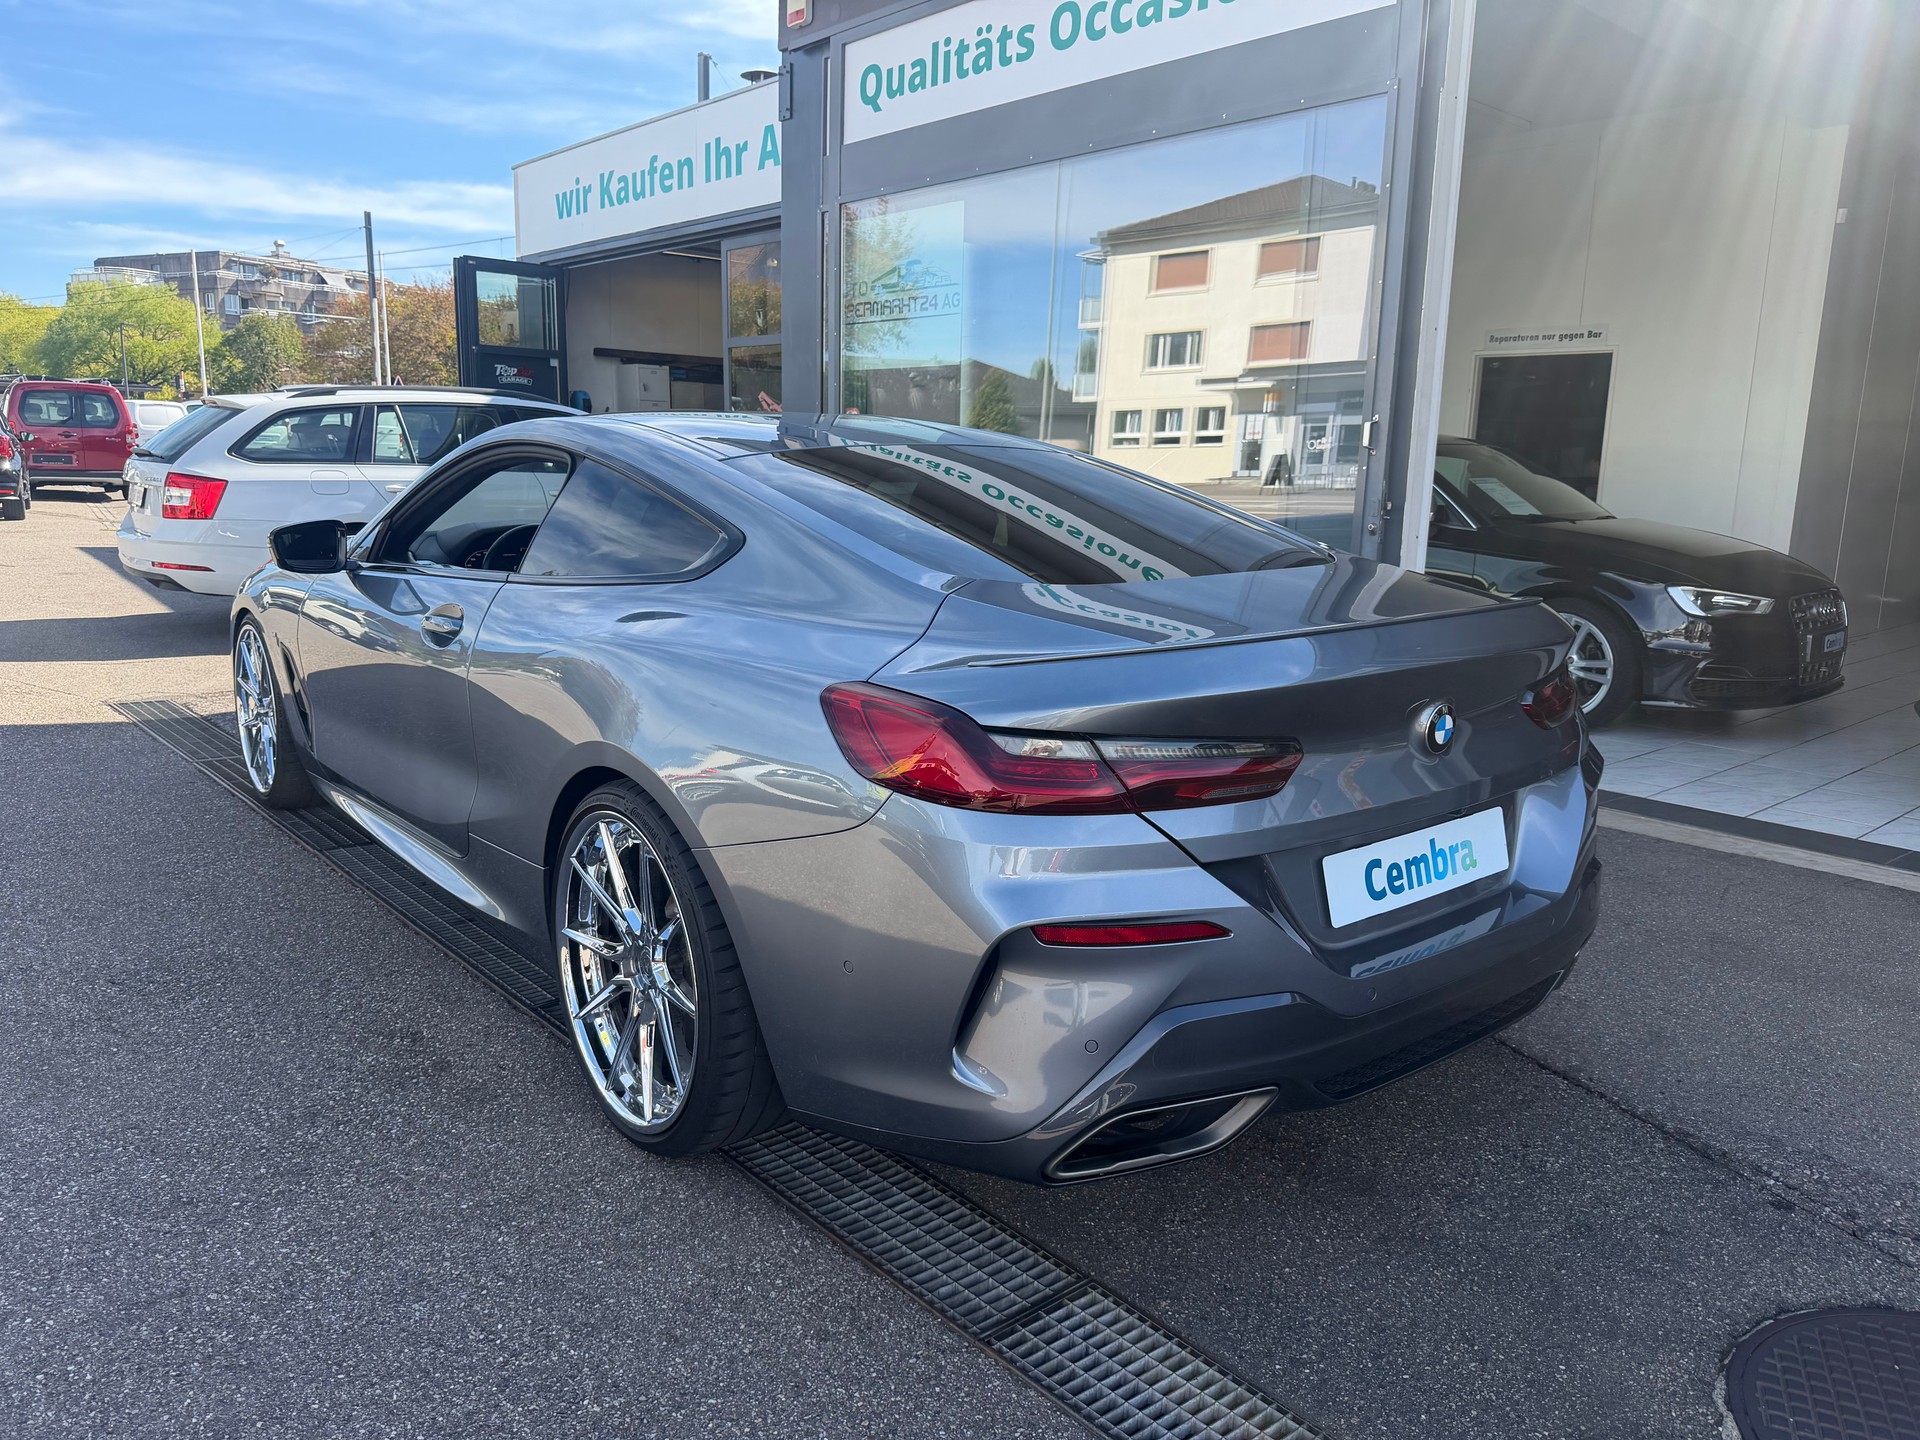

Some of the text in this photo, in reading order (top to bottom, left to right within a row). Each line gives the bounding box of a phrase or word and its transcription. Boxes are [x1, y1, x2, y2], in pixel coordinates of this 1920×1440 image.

[860, 0, 1237, 113] Qualitäts Occas
[555, 177, 592, 220] wir
[599, 154, 694, 209] Kaufen
[704, 136, 748, 184] Ihr
[942, 292, 960, 309] AG
[1489, 334, 1539, 344] Reparaturen
[1558, 331, 1584, 342] gegen
[1587, 330, 1602, 339] Bar
[631, 806, 659, 840] Continental
[1364, 838, 1477, 901] Cembra
